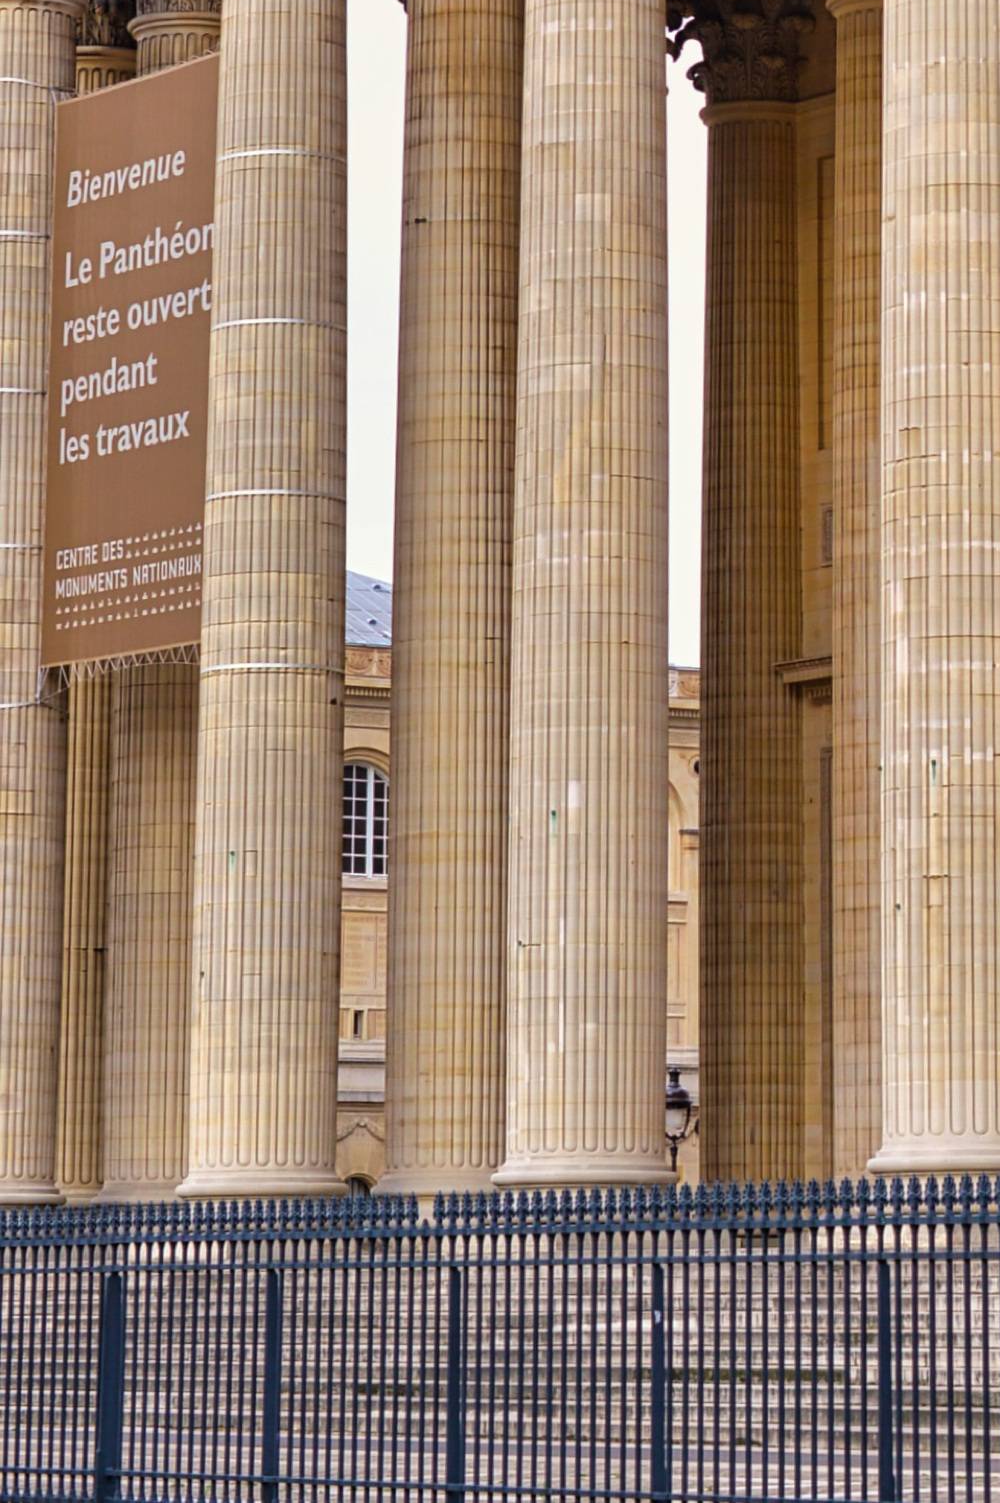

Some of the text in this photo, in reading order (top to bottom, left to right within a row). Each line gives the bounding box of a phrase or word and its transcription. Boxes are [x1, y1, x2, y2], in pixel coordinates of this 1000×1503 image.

[66, 149, 186, 208] Bienvenue
[65, 251, 92, 288] Le
[63, 278, 212, 346] reste ouvert
[60, 352, 158, 417] pendant
[59, 410, 190, 465] les travaux
[55, 553, 202, 599] MONUMENTS NATIONAUX
[56, 539, 123, 570] CENTRE DES
